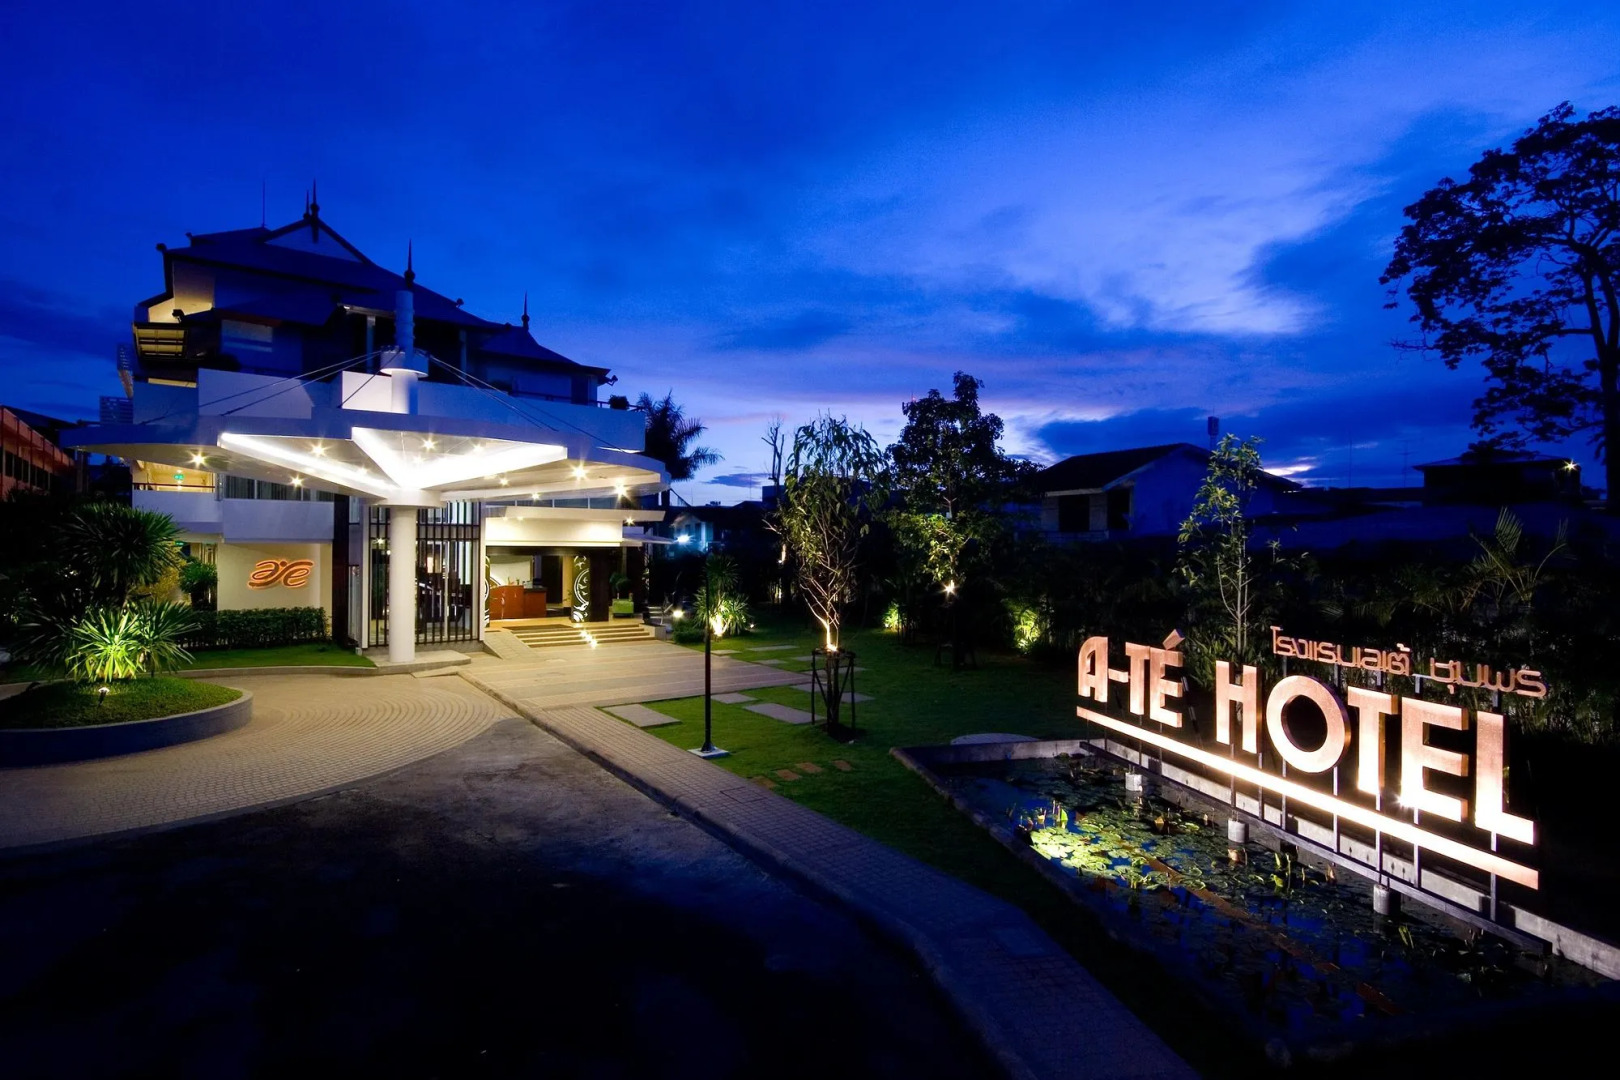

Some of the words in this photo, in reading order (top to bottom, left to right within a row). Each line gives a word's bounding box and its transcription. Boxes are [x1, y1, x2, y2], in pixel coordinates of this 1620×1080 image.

[1078, 629, 1184, 728] A-TÉ
[1215, 660, 1536, 845] HOTEL
[1430, 656, 1548, 698] ชุมพร
